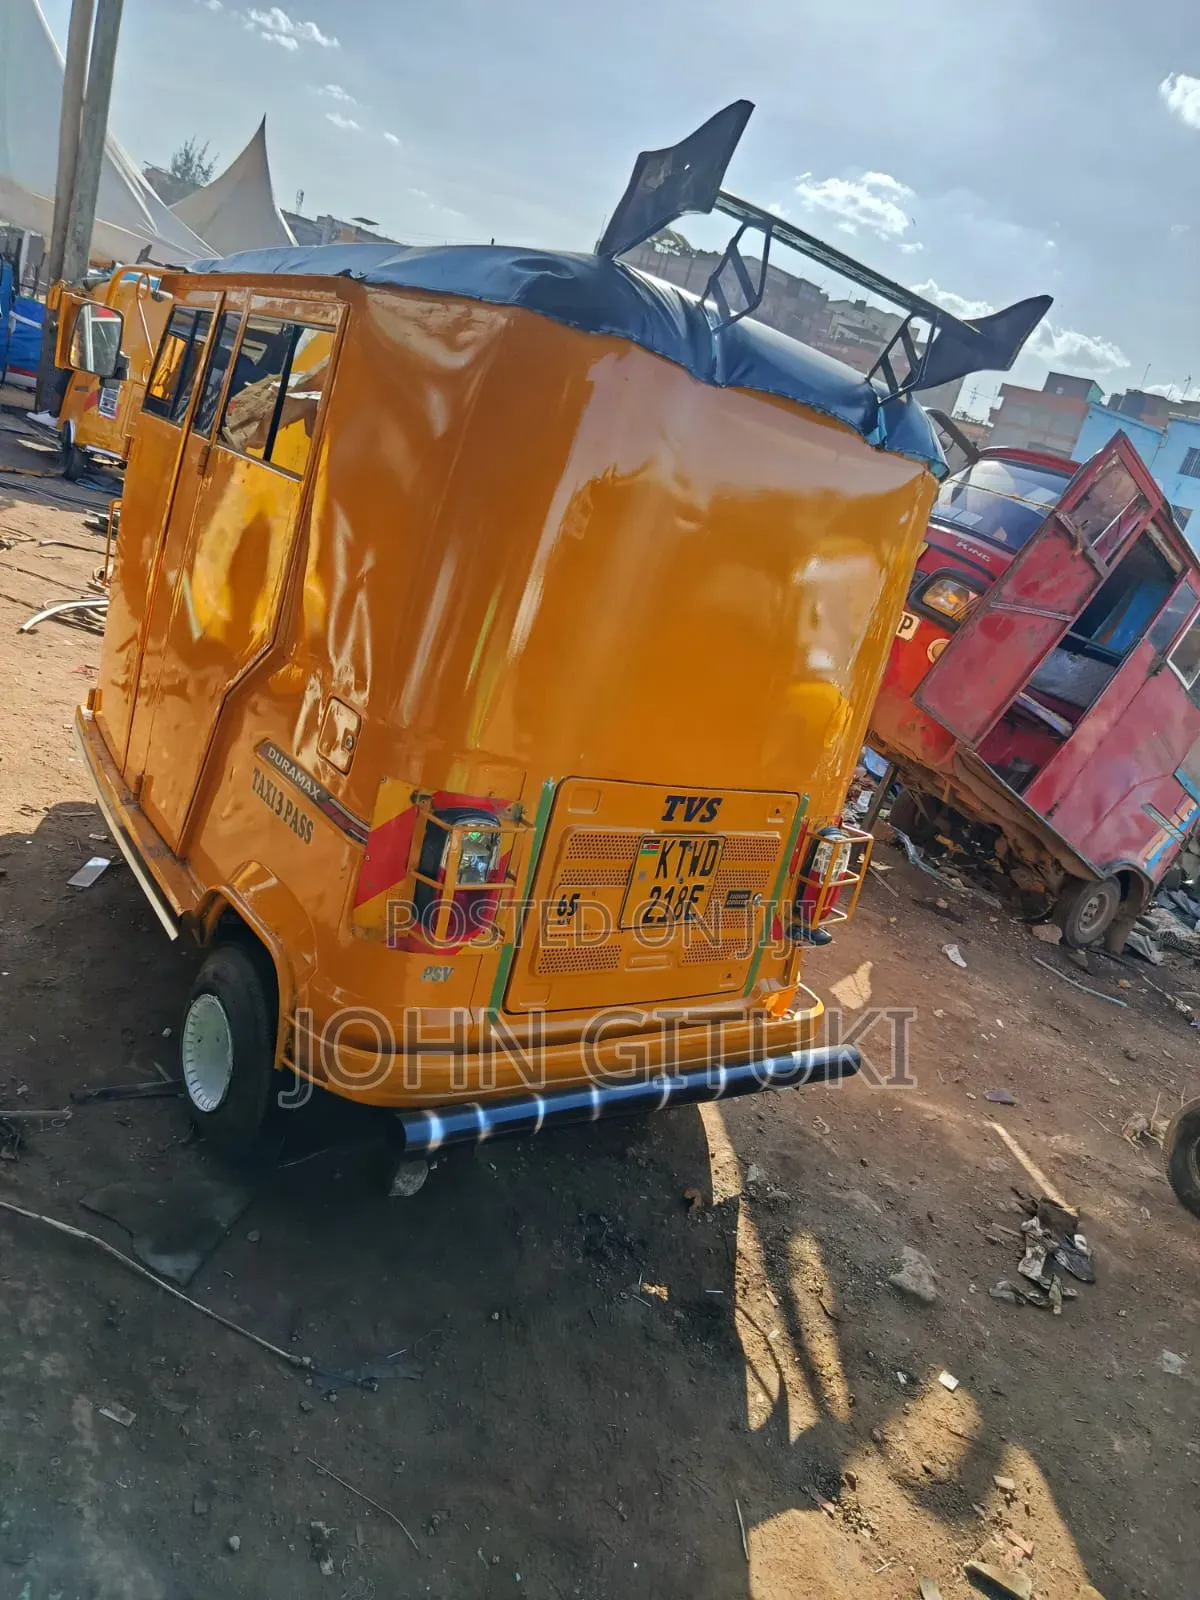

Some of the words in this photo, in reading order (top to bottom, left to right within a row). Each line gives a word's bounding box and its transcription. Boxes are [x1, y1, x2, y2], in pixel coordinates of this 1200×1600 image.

[267, 746, 320, 801] DURAMAX
[284, 799, 314, 845] PASS
[661, 795, 723, 823] TVS
[655, 839, 720, 879] KTWD
[557, 893, 581, 917] 65
[641, 884, 705, 924] 218E
[421, 966, 455, 983] PSV
